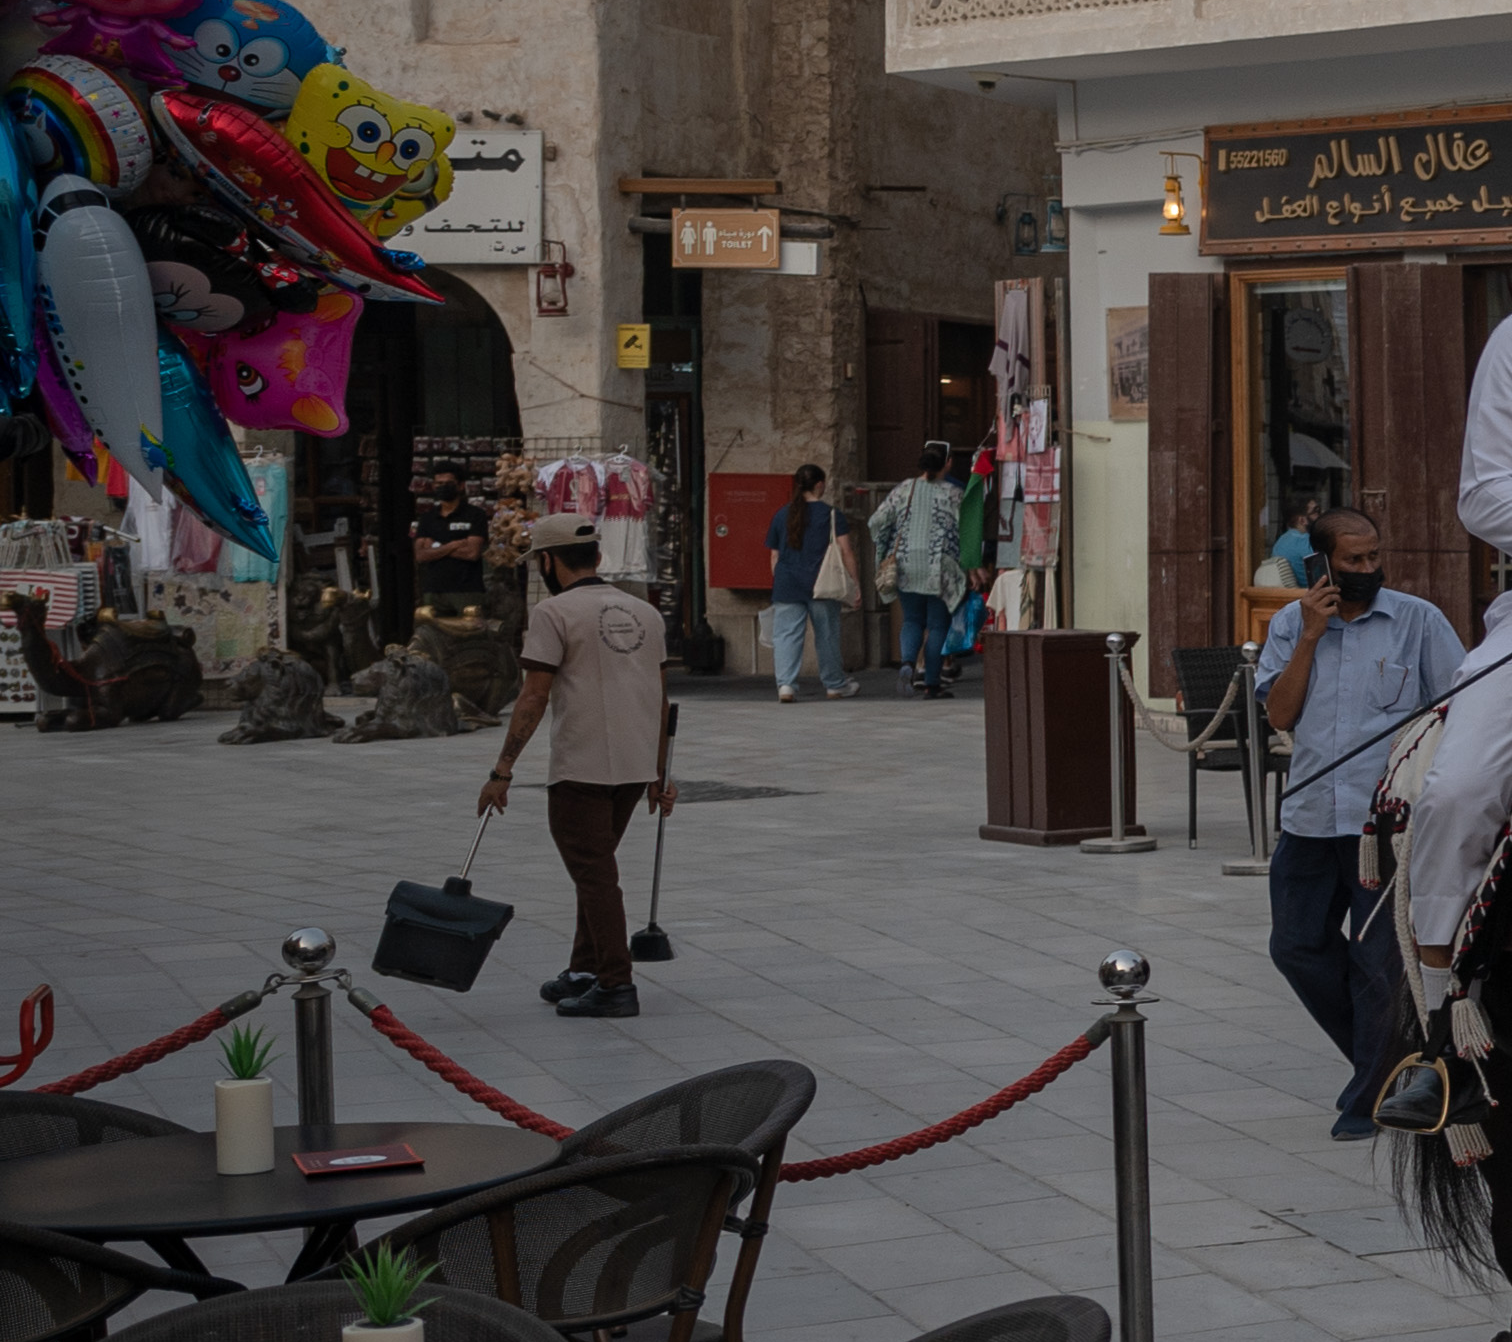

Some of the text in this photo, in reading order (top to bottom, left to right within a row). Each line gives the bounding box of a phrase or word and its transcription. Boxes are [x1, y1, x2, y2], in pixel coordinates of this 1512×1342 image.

[1229, 148, 1289, 170] 55221560
[1308, 131, 1492, 189] عقال السالم
[1326, 184, 1393, 226] أنواع
[1399, 192, 1464, 222] جميع
[424, 218, 525, 233] للتحف
[721, 240, 753, 249] TOILET
